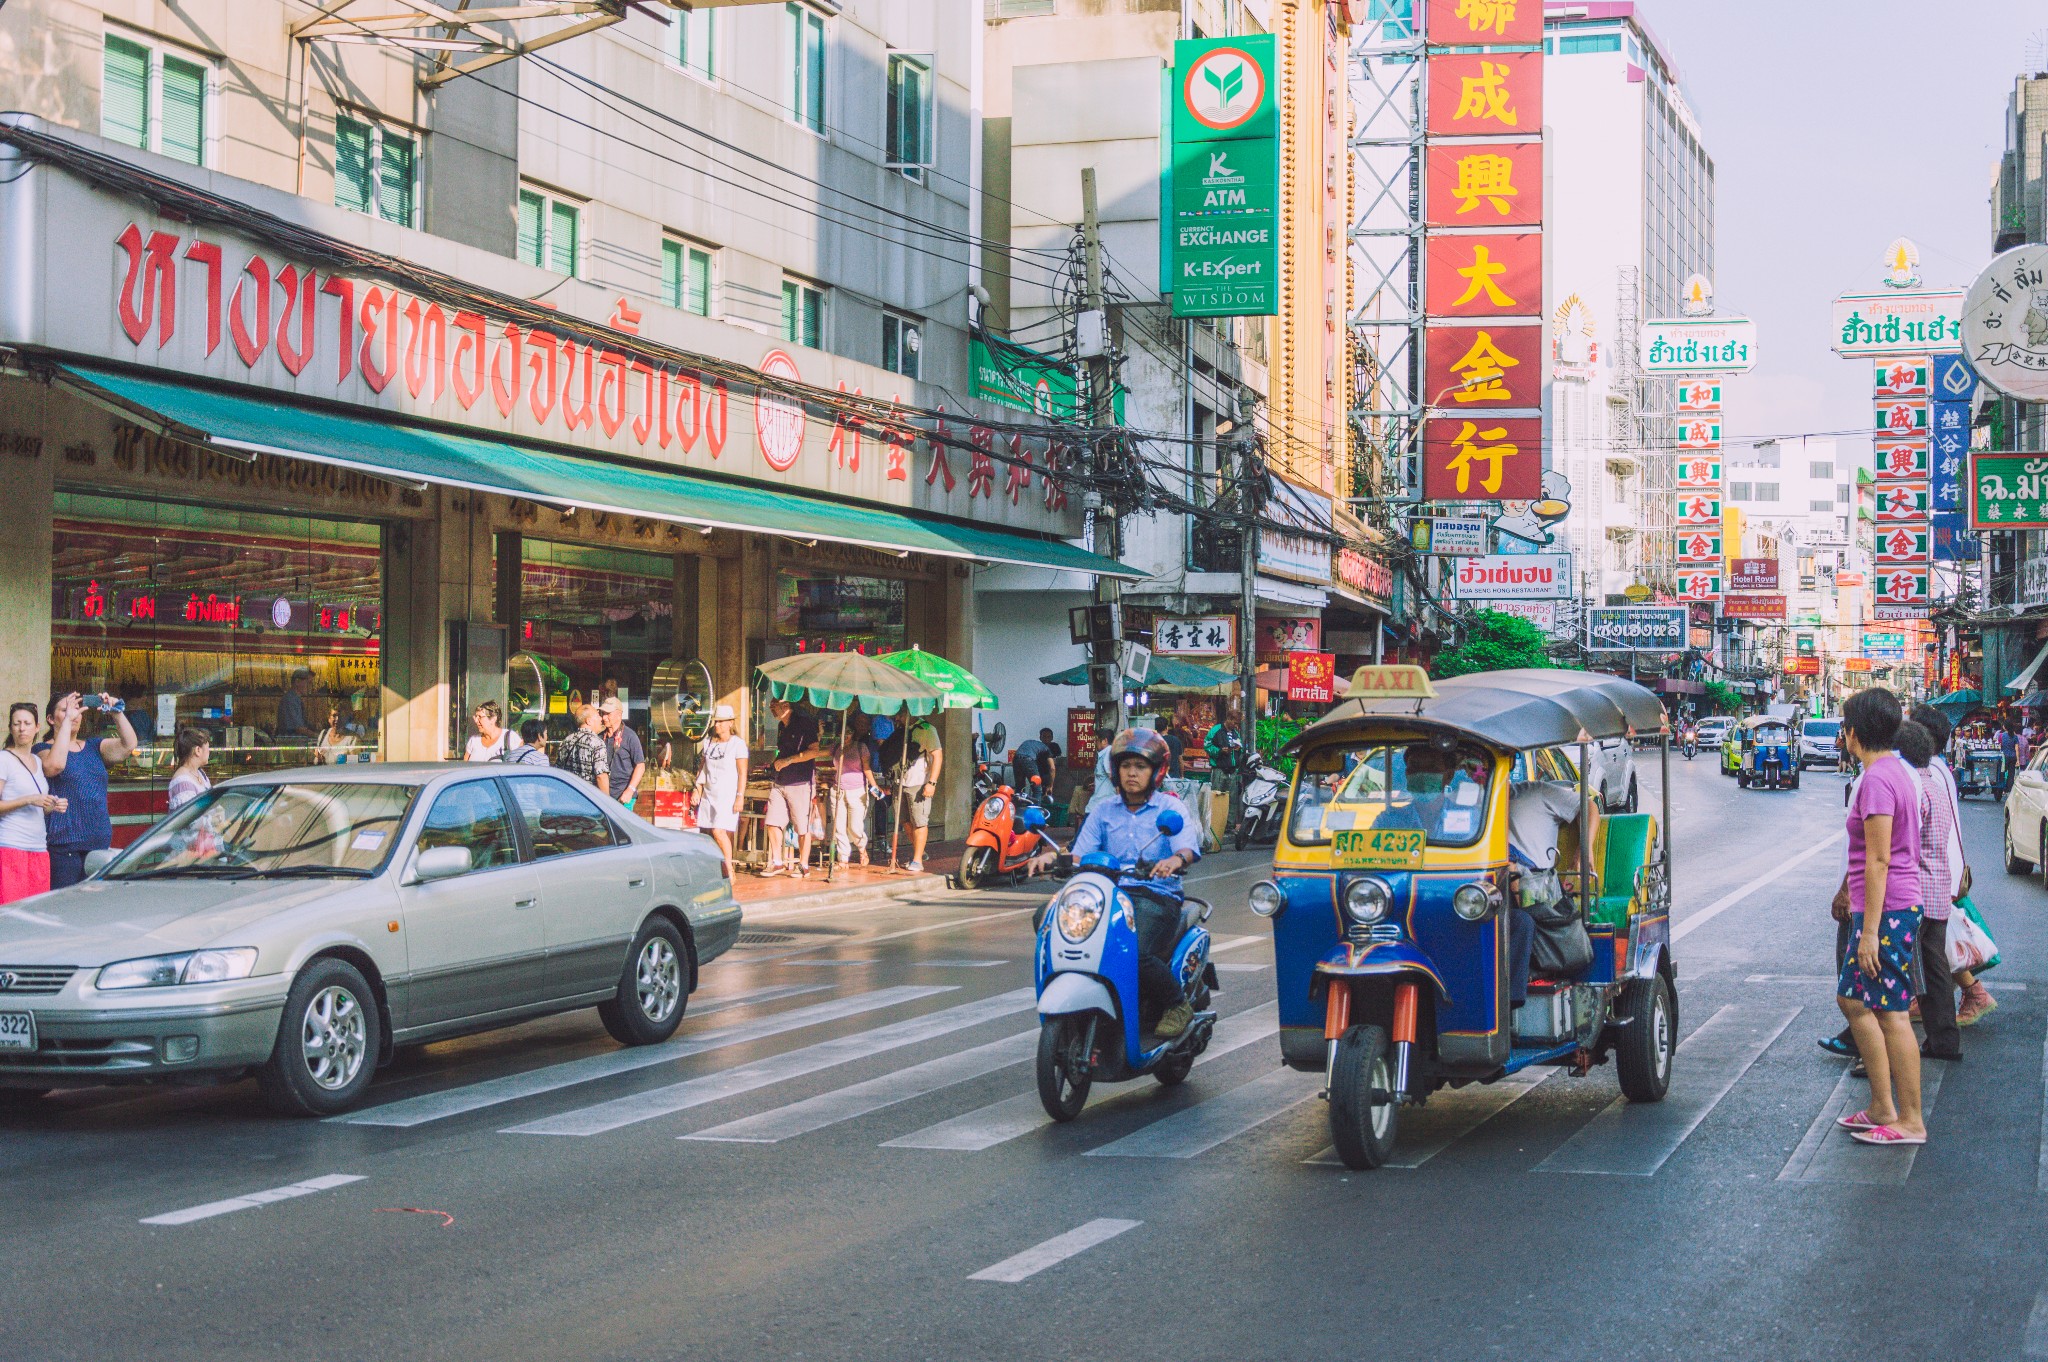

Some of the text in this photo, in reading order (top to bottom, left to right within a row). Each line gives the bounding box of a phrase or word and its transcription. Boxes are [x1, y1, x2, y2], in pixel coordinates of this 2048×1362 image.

[1203, 189, 1246, 207] ATM
[1180, 230, 1268, 246] EXCHANGE
[1184, 255, 1261, 279] K-Expert
[1183, 292, 1265, 306] WISDOM
[1869, 303, 1935, 314] ห้างขายทอง
[1842, 311, 1960, 344] ฮั่วเซ่งเฮง
[1649, 335, 1748, 363] ฮั่วเซ่งเฮง
[1687, 384, 1712, 596] 和成興大金行
[1887, 365, 1916, 601] 和成興大金行
[1436, 522, 1481, 533] แสงอรุณ
[1733, 575, 1776, 583] Hotel Royal
[1359, 670, 1415, 690] TAXI
[1291, 685, 1329, 700] เกาลัด
[1371, 832, 1421, 852] 4232
[0, 1016, 29, 1035] 322
